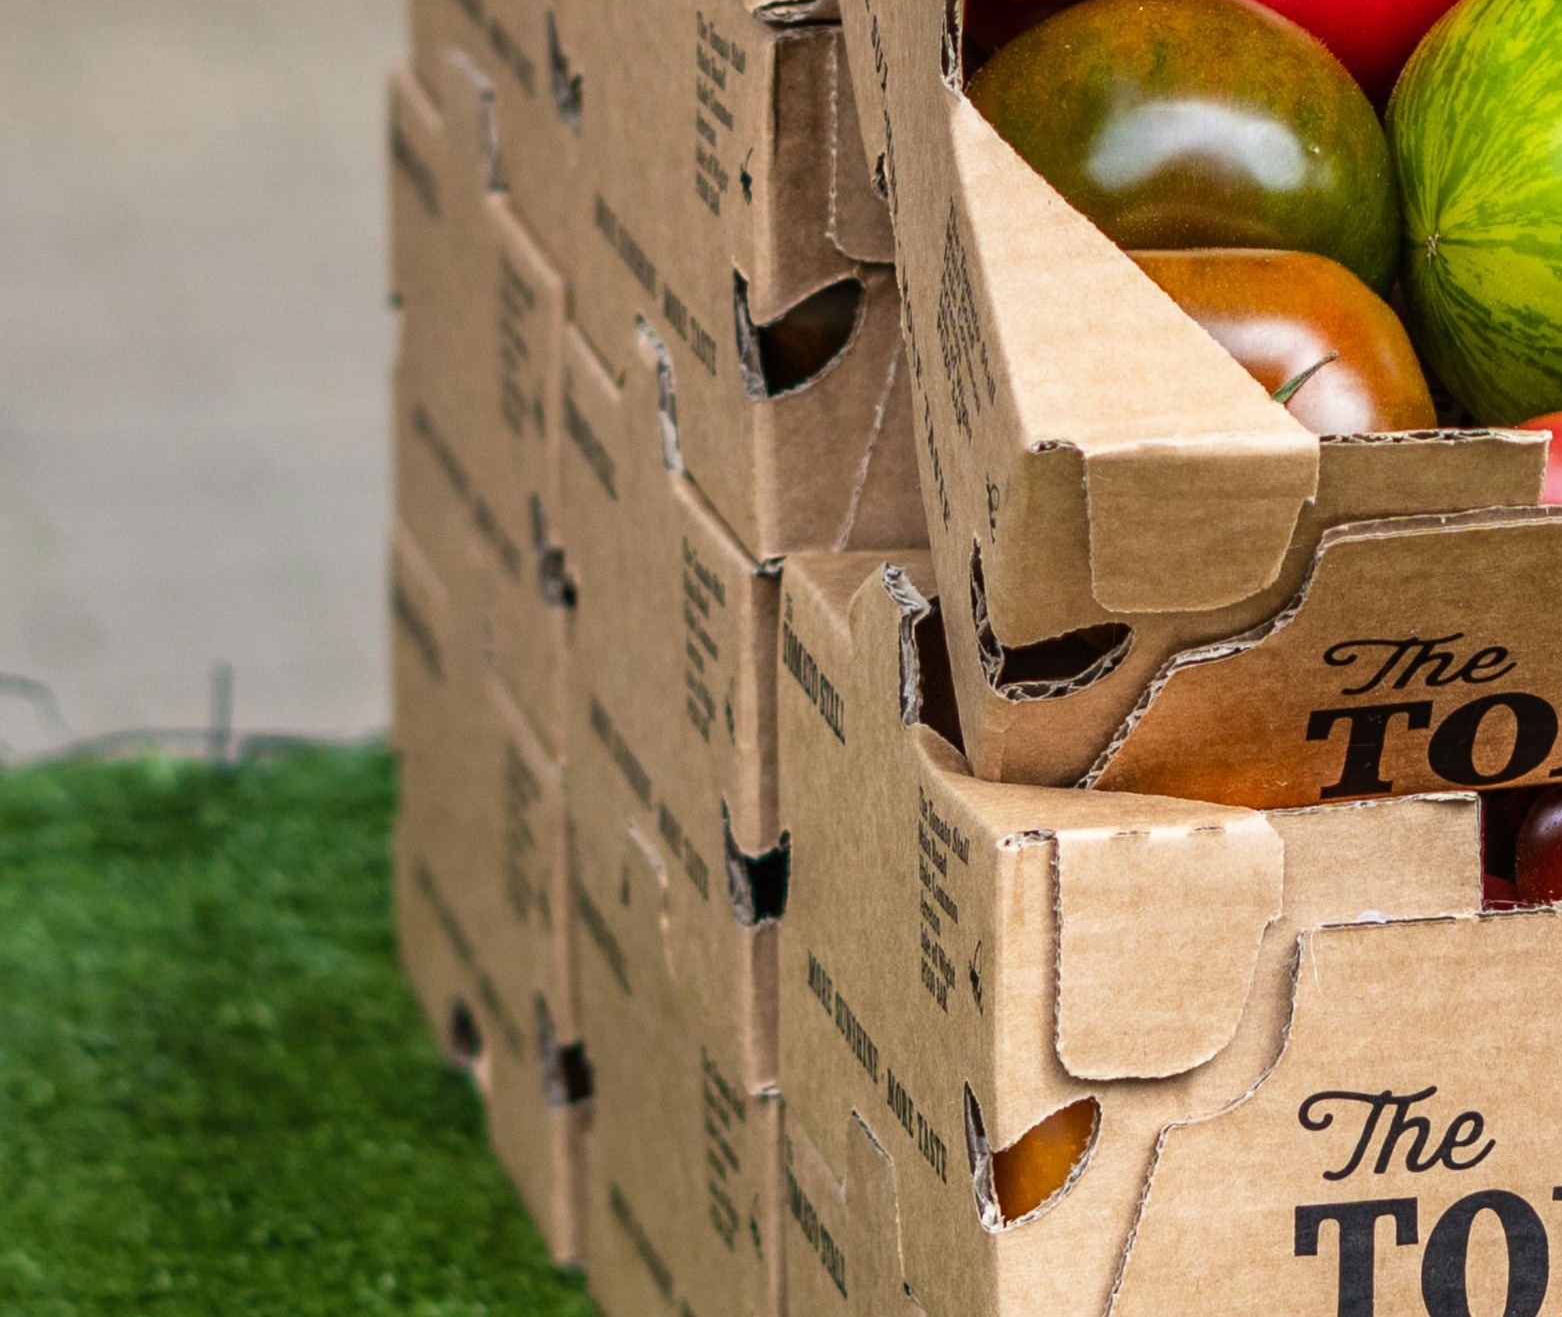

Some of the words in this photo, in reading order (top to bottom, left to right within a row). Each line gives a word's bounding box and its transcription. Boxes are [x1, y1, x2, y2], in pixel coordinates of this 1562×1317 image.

[1322, 631, 1518, 696] The
[820, 673, 846, 746] STALL
[887, 1067, 914, 1139] MORE
[917, 1111, 947, 1185] TASTE
[1298, 1084, 1497, 1182] The
